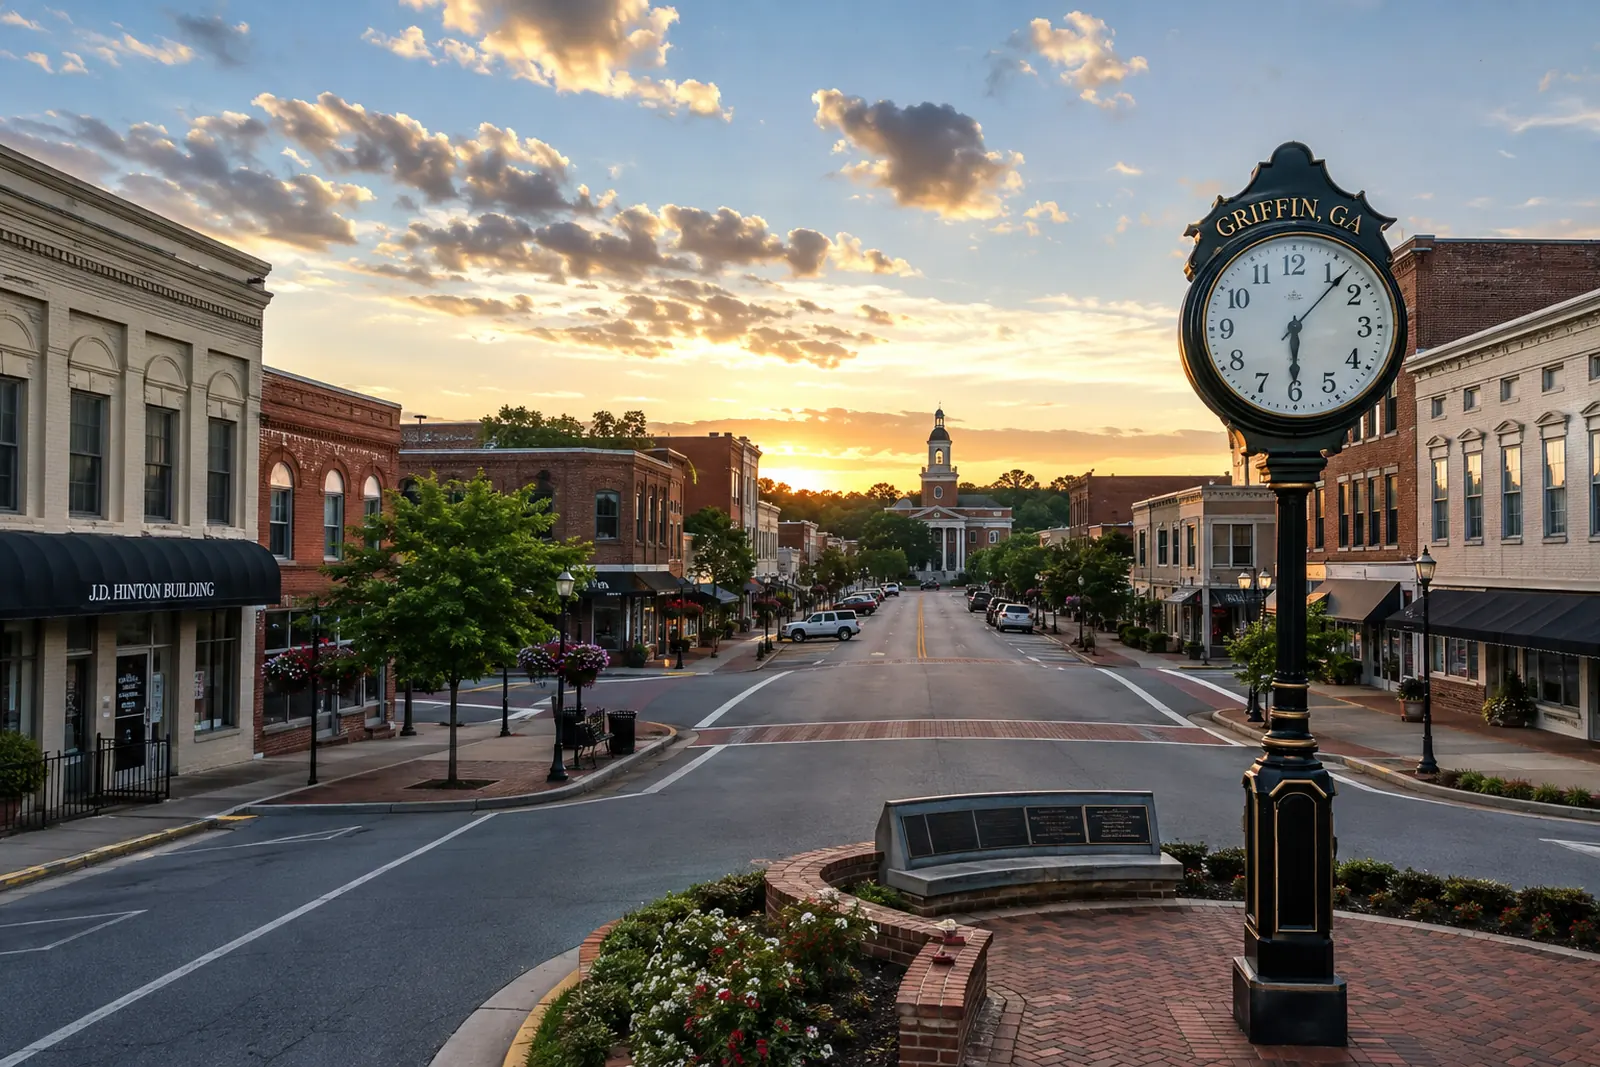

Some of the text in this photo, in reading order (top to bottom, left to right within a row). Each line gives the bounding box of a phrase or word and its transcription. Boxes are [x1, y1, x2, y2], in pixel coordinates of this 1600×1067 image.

[1216, 197, 1362, 237] GRIFFIN, GA
[1252, 263, 1271, 285] 11
[1282, 254, 1305, 276] 12
[1323, 262, 1335, 284] 1
[1227, 288, 1250, 309] 10
[1346, 284, 1362, 306] 2
[1219, 318, 1235, 340] 9
[1357, 316, 1372, 338] 3
[1229, 349, 1244, 371] 8
[1345, 348, 1361, 370] 4
[1255, 372, 1270, 394] 7
[1287, 379, 1303, 402] 6
[1321, 372, 1337, 394] 5
[89, 582, 215, 601] J.D. HINTON BUILDING
